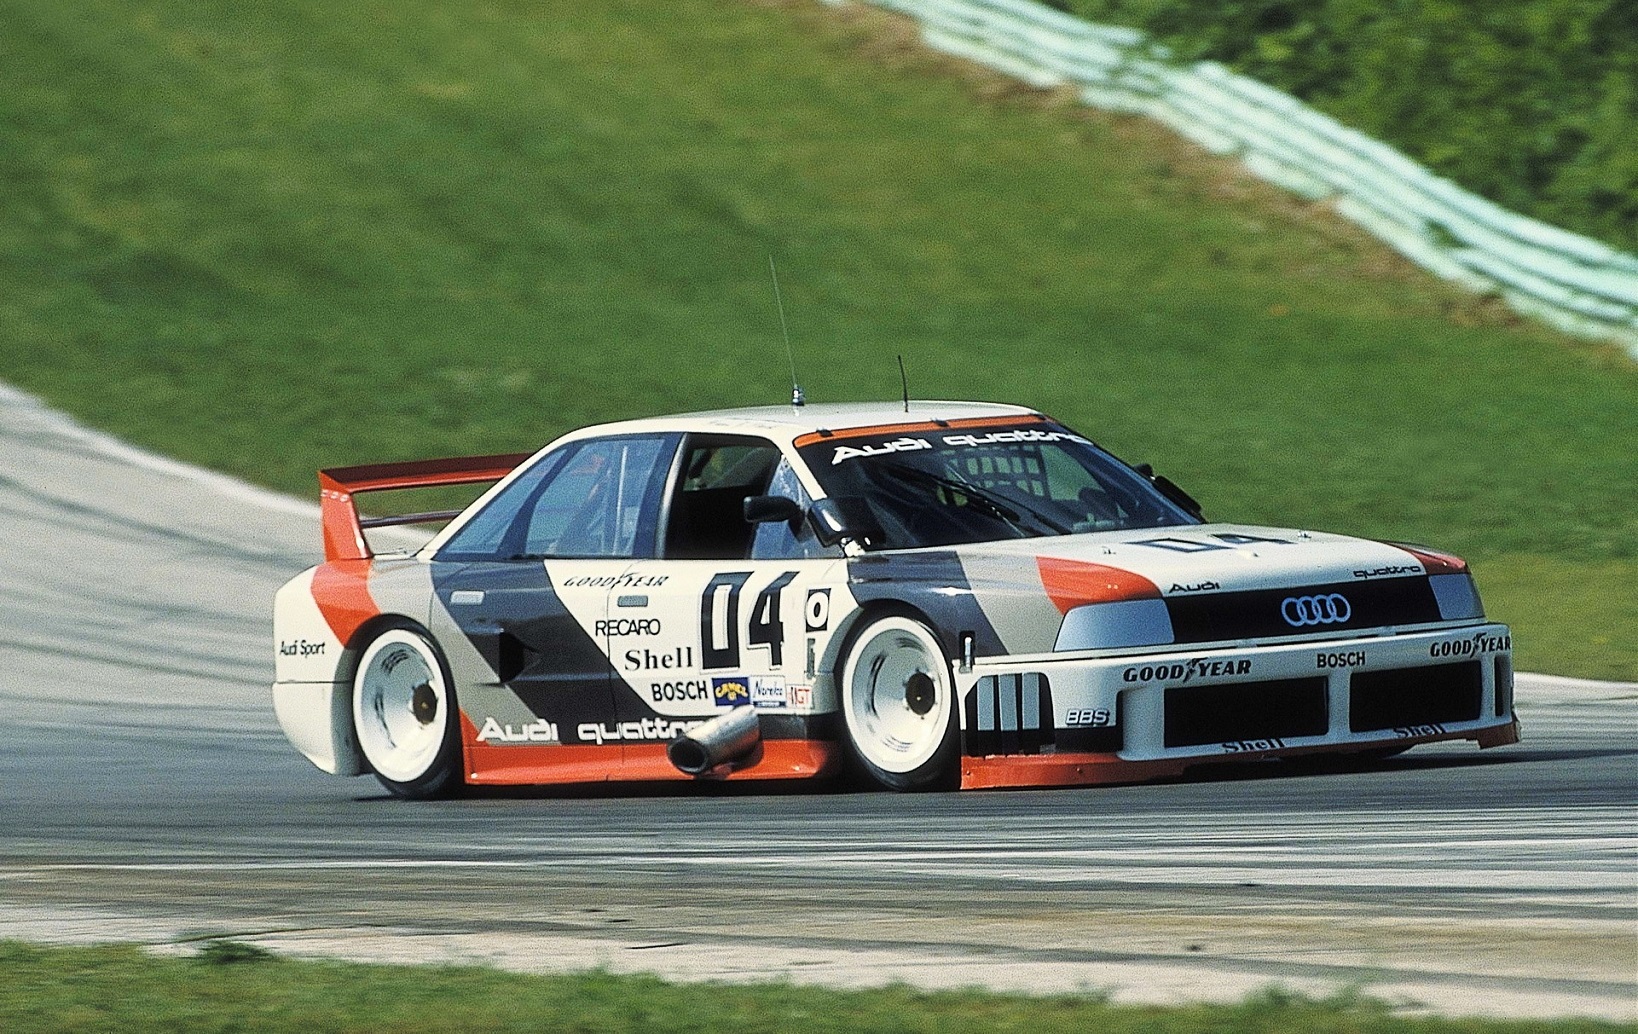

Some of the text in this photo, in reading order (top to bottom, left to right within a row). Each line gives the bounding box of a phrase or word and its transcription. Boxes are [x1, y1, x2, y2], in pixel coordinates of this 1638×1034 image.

[831, 437, 932, 465] Audi
[1353, 565, 1421, 579] quattro
[1169, 581, 1220, 593] Audi
[595, 618, 661, 637] RECARO
[700, 571, 800, 670] 04
[279, 639, 326, 658] Audi Sport
[624, 646, 693, 671] Shell
[1316, 651, 1366, 669] BOSCH
[1123, 657, 1252, 683] GOODYEAR
[651, 680, 709, 702] BOSCH
[1066, 708, 1110, 726] BBS
[476, 717, 559, 742] Audi
[1221, 737, 1285, 754] Shell
